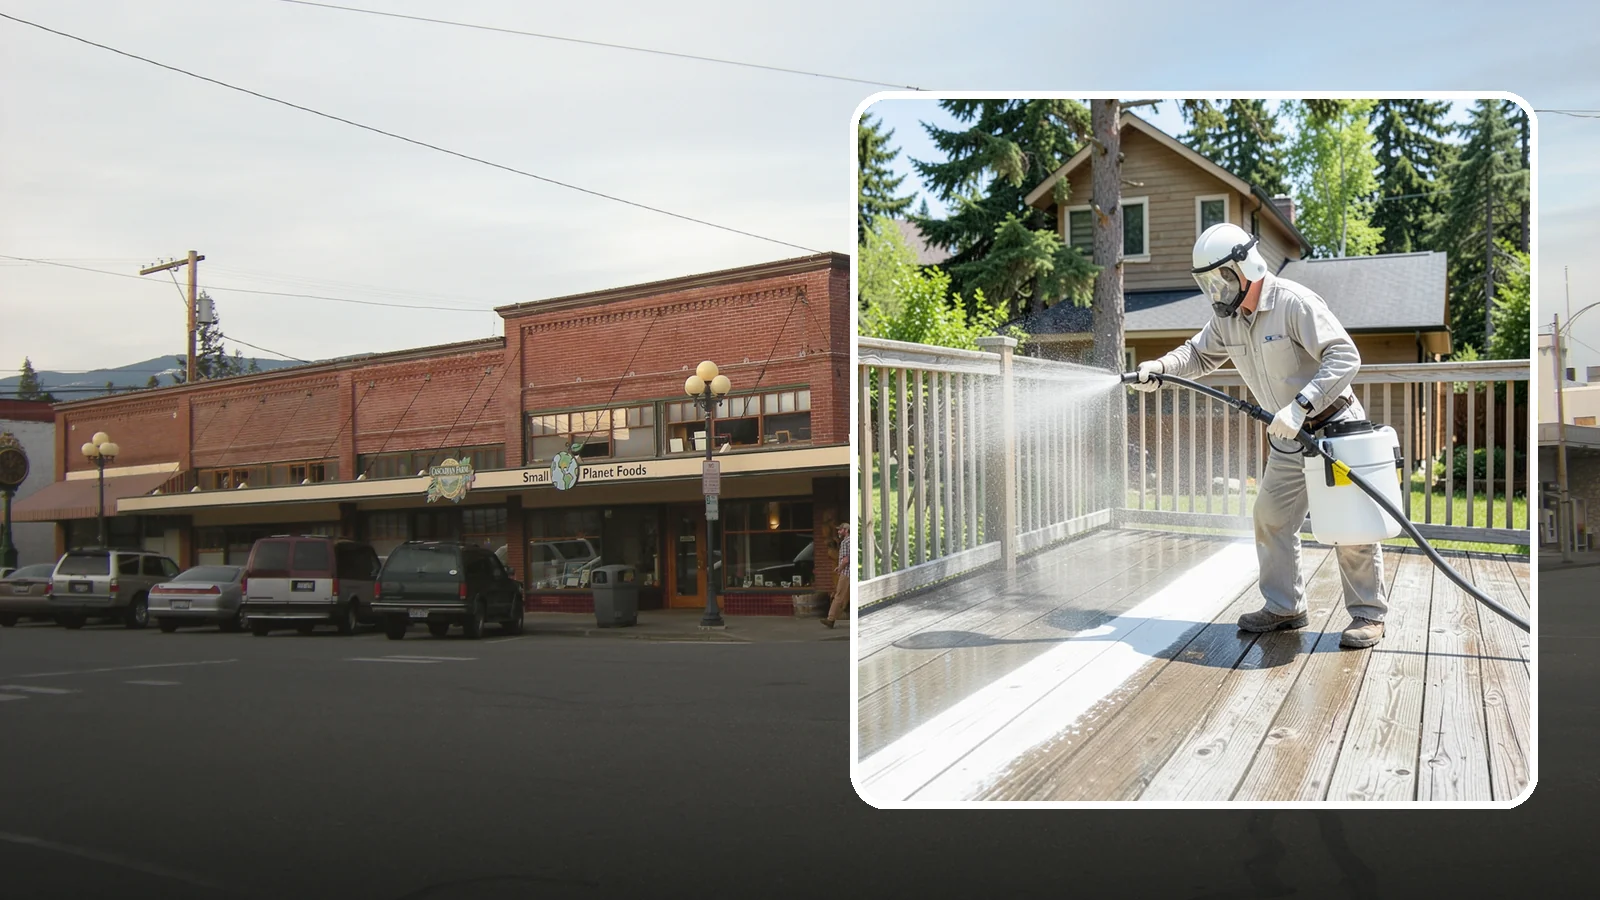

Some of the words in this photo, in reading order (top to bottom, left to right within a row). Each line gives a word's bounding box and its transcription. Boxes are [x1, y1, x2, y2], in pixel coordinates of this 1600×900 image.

[523, 471, 549, 483] Small
[583, 468, 614, 479] Planet
[617, 465, 647, 477] Foods
